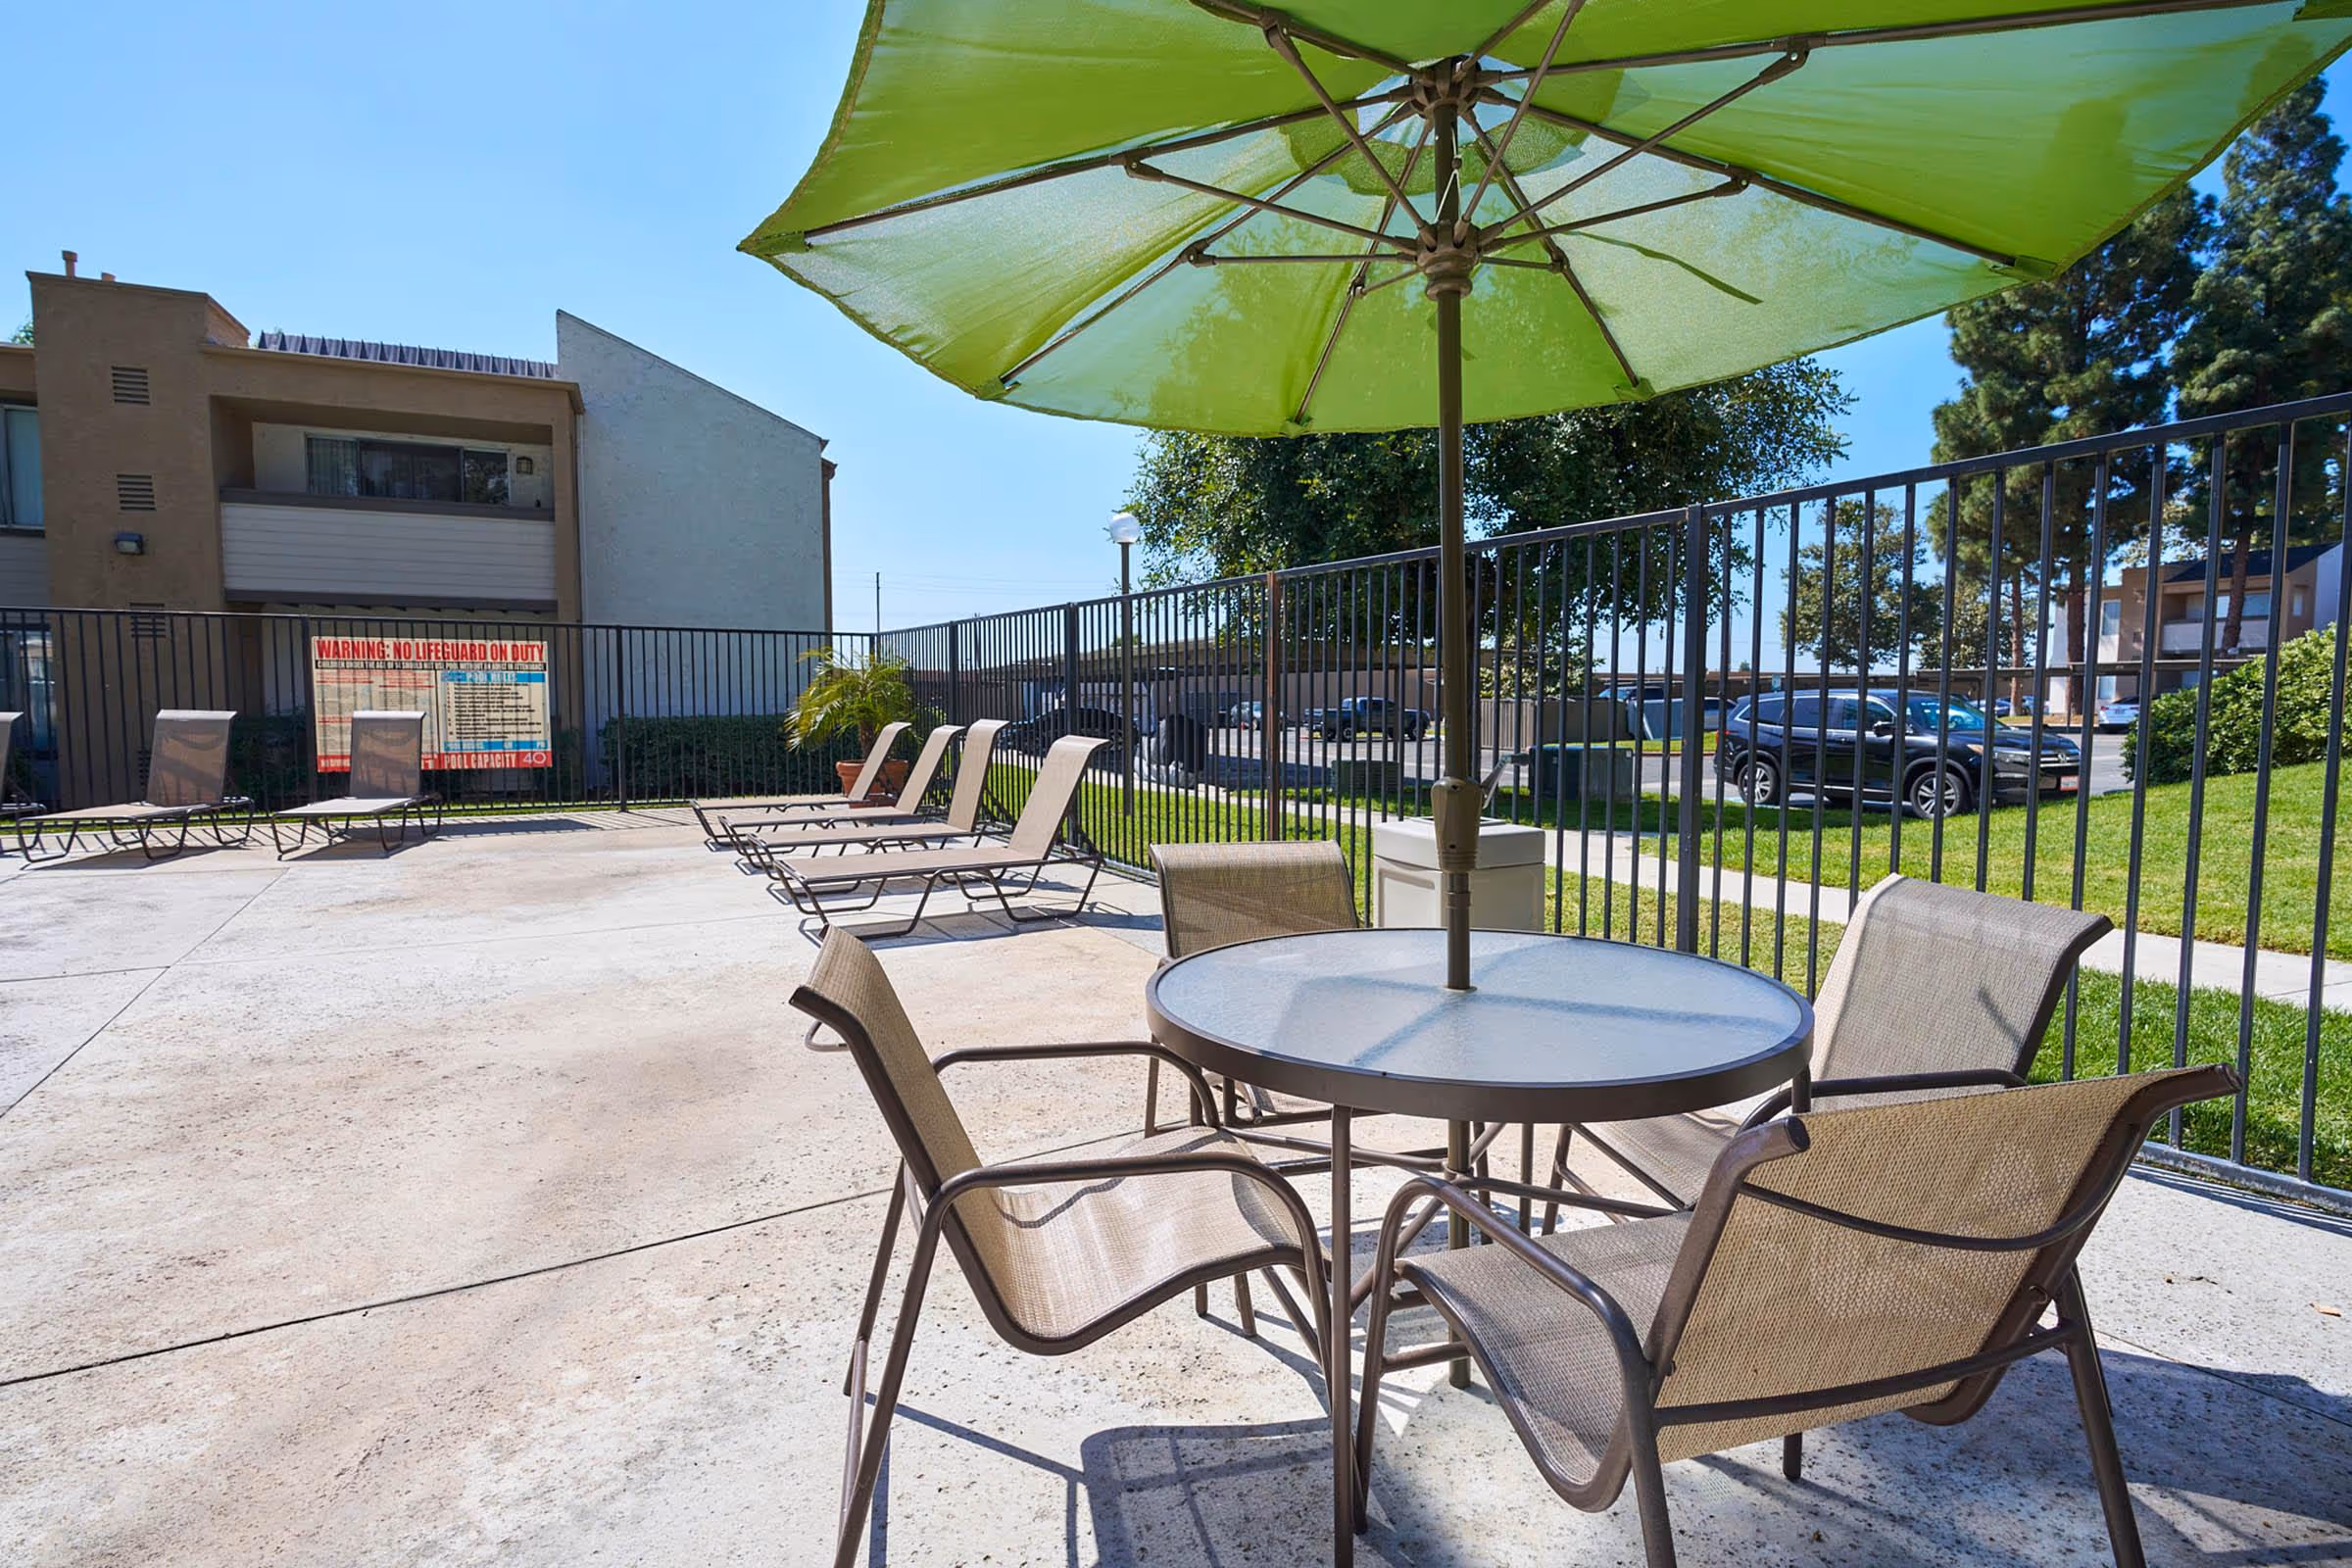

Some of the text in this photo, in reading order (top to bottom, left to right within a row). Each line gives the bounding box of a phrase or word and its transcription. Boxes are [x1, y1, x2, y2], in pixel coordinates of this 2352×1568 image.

[316, 640, 544, 662] WARNING: NO LIFEGUARD ON DUTY
[466, 671, 487, 682] POOL
[444, 753, 468, 768] POOL
[470, 753, 516, 768] CAPACITY
[523, 752, 547, 764] 40
